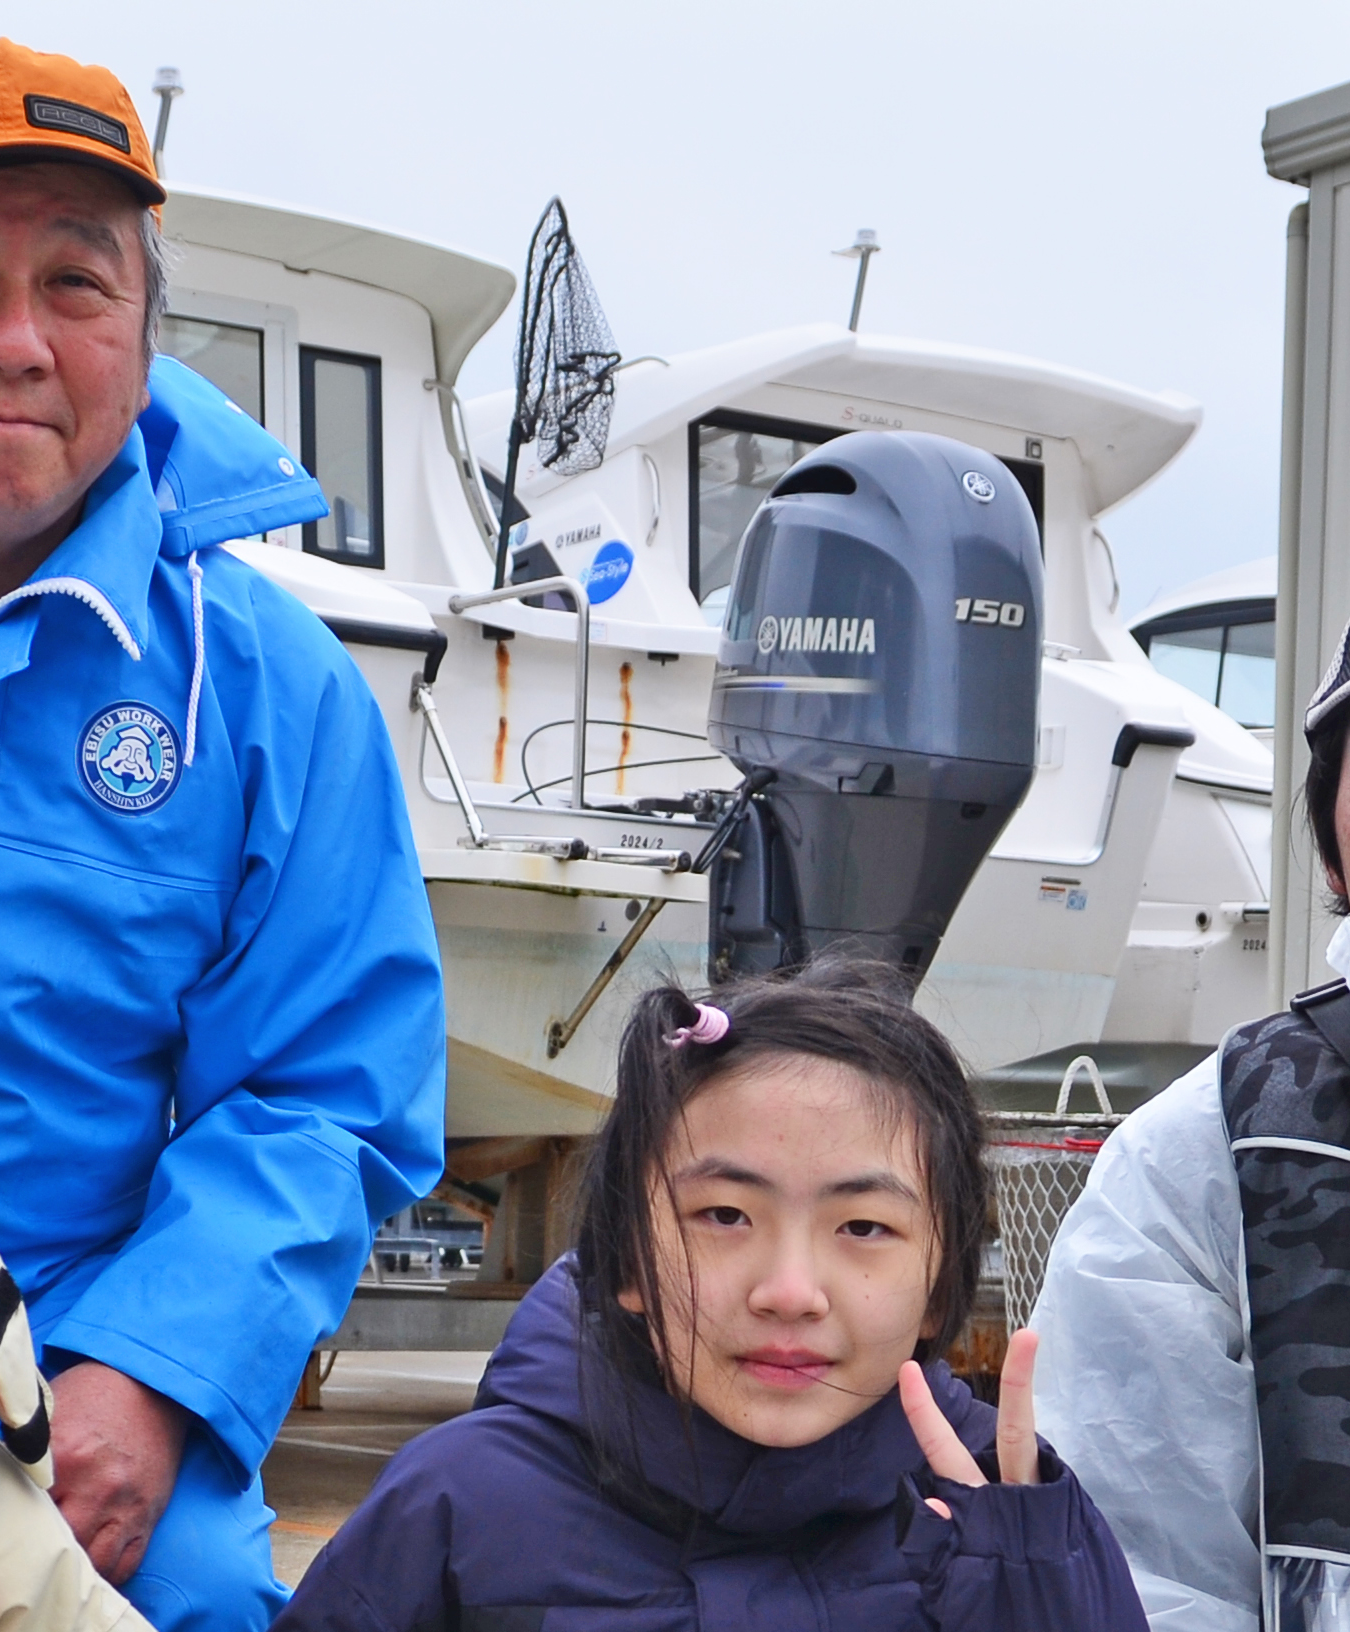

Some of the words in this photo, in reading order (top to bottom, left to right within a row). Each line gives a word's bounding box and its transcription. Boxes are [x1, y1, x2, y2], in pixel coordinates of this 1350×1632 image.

[565, 524, 602, 546] YAMAHA
[954, 597, 1027, 629] 150
[779, 617, 877, 655] YAMAHA
[85, 715, 115, 763] EBISU
[117, 710, 163, 735] WORK
[158, 733, 175, 782] WEAR
[93, 779, 136, 808] HANSHIN
[620, 833, 664, 850] 2024/2
